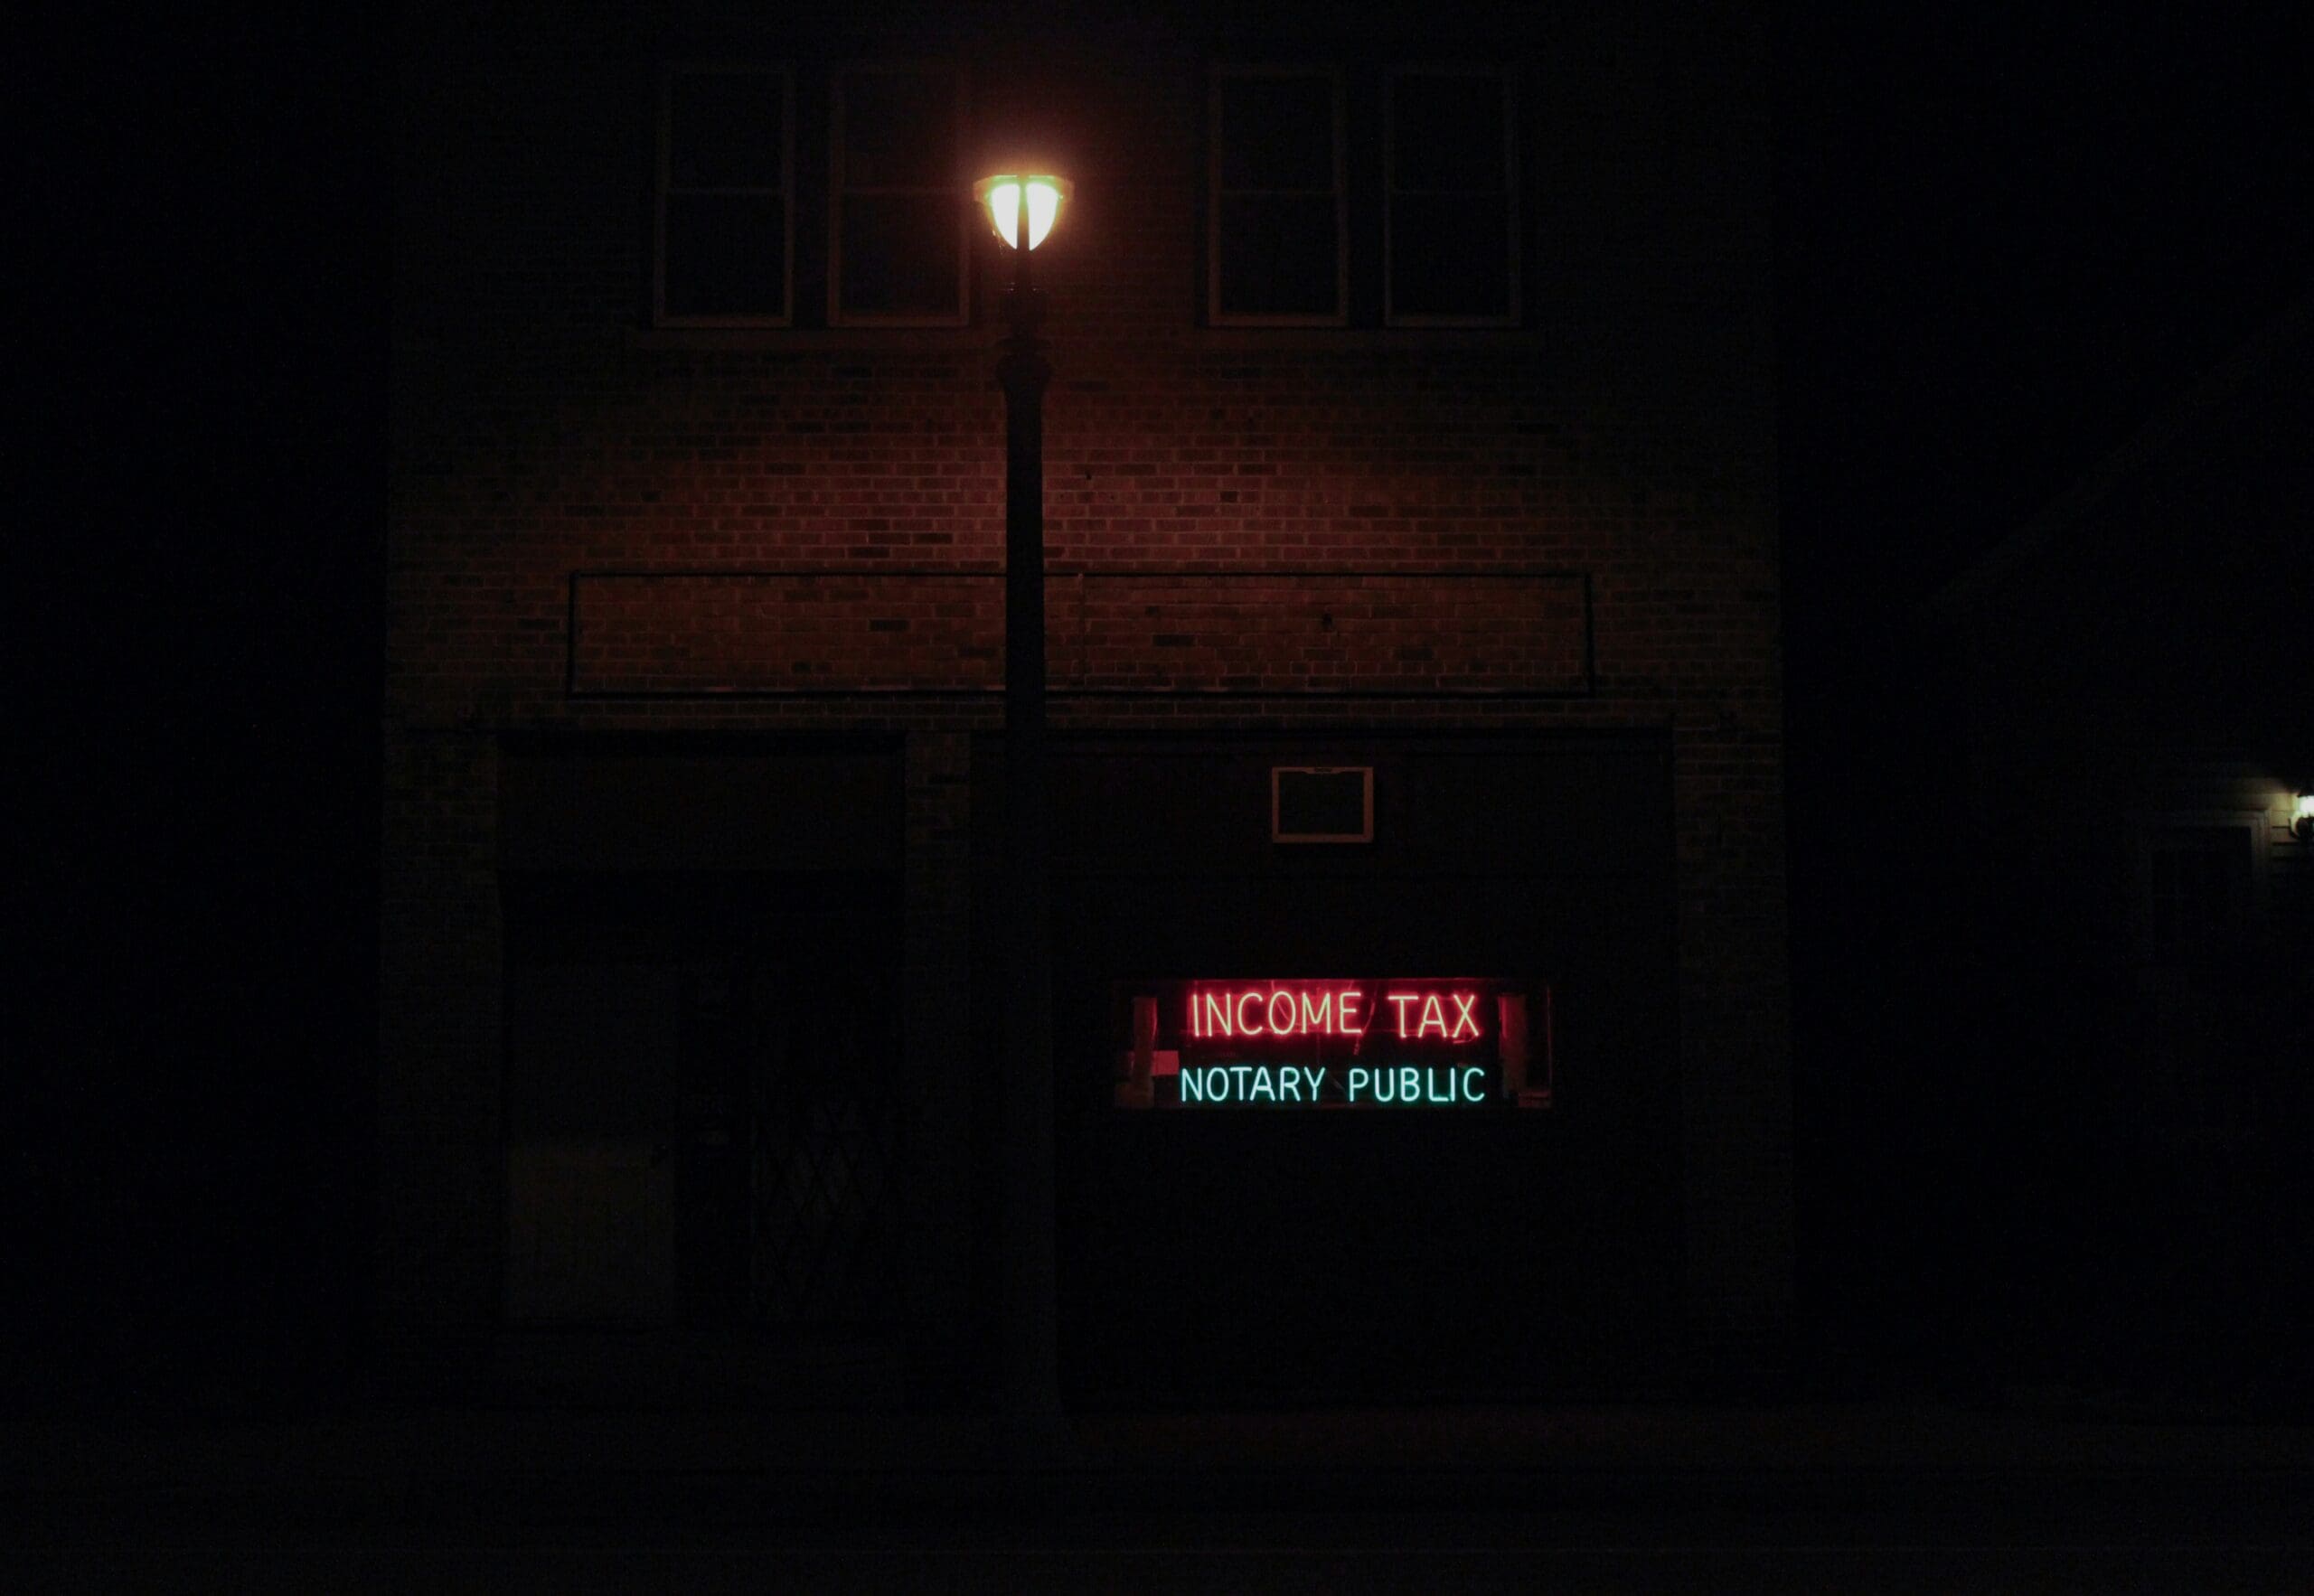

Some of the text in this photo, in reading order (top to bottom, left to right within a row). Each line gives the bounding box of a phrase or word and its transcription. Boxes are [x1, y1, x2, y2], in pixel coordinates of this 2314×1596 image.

[1190, 990, 1480, 1039] INCOME TAX
[1180, 1066, 1486, 1103] NOTARY PUBLIC
